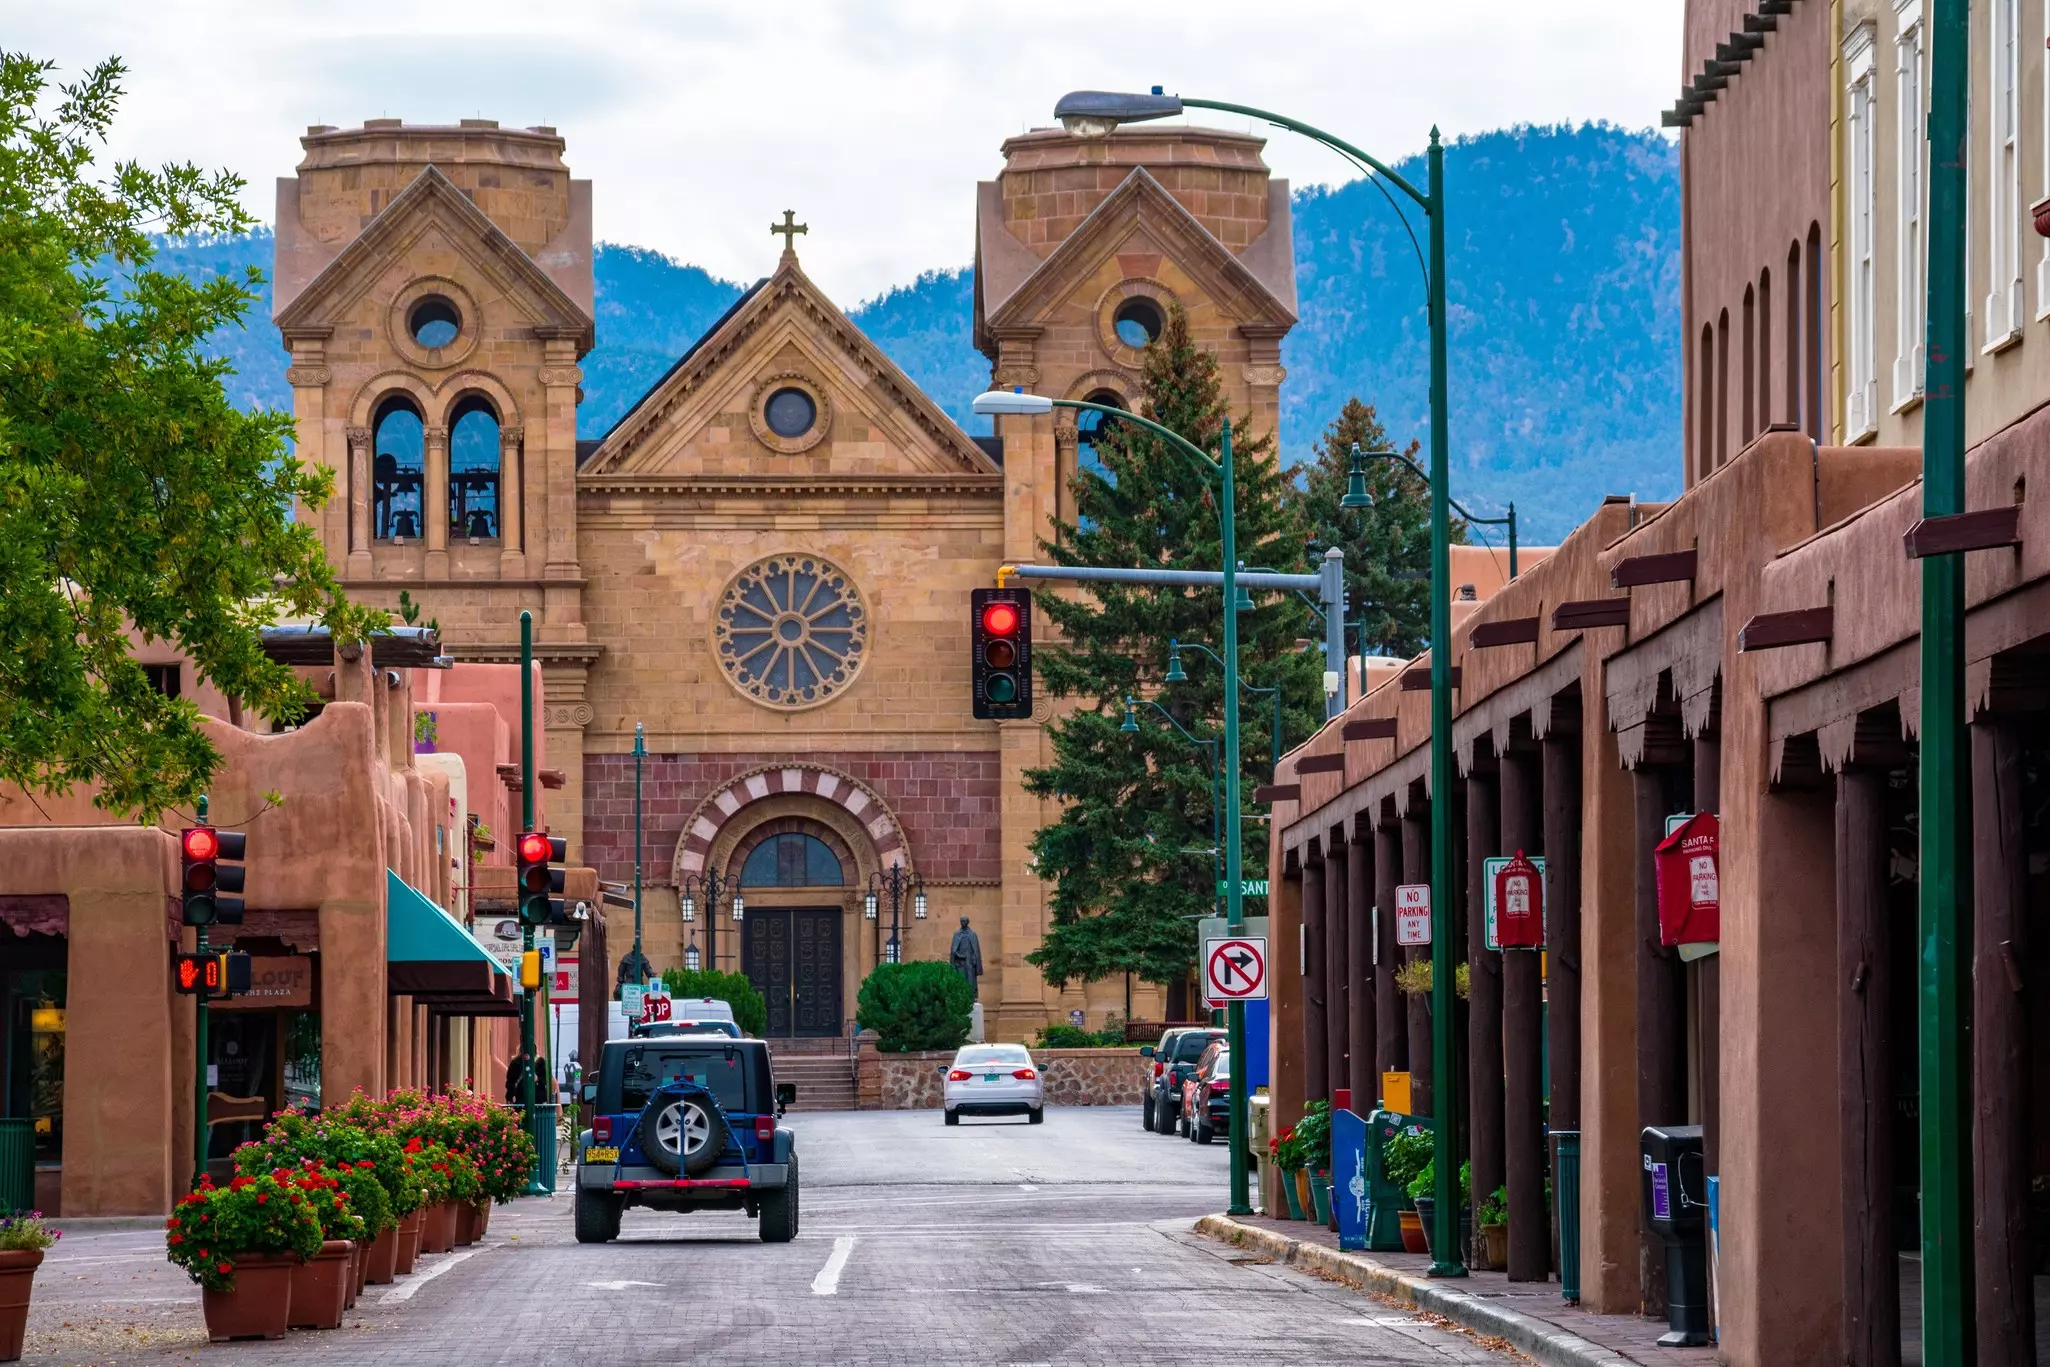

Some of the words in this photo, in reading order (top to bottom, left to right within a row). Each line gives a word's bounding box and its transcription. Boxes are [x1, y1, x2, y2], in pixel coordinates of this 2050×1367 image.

[1681, 835, 1709, 848] SANTA
[1699, 861, 1708, 870] NO
[1692, 872, 1716, 882] PARKING
[1241, 880, 1270, 895] SANT
[1513, 879, 1522, 887] NO
[1406, 891, 1420, 903] NO
[1507, 889, 1528, 897] PARKING
[1398, 906, 1429, 918] PARKING
[1407, 920, 1420, 928] ANY
[1407, 931, 1422, 939] TIME
[252, 969, 305, 988] LOUF
